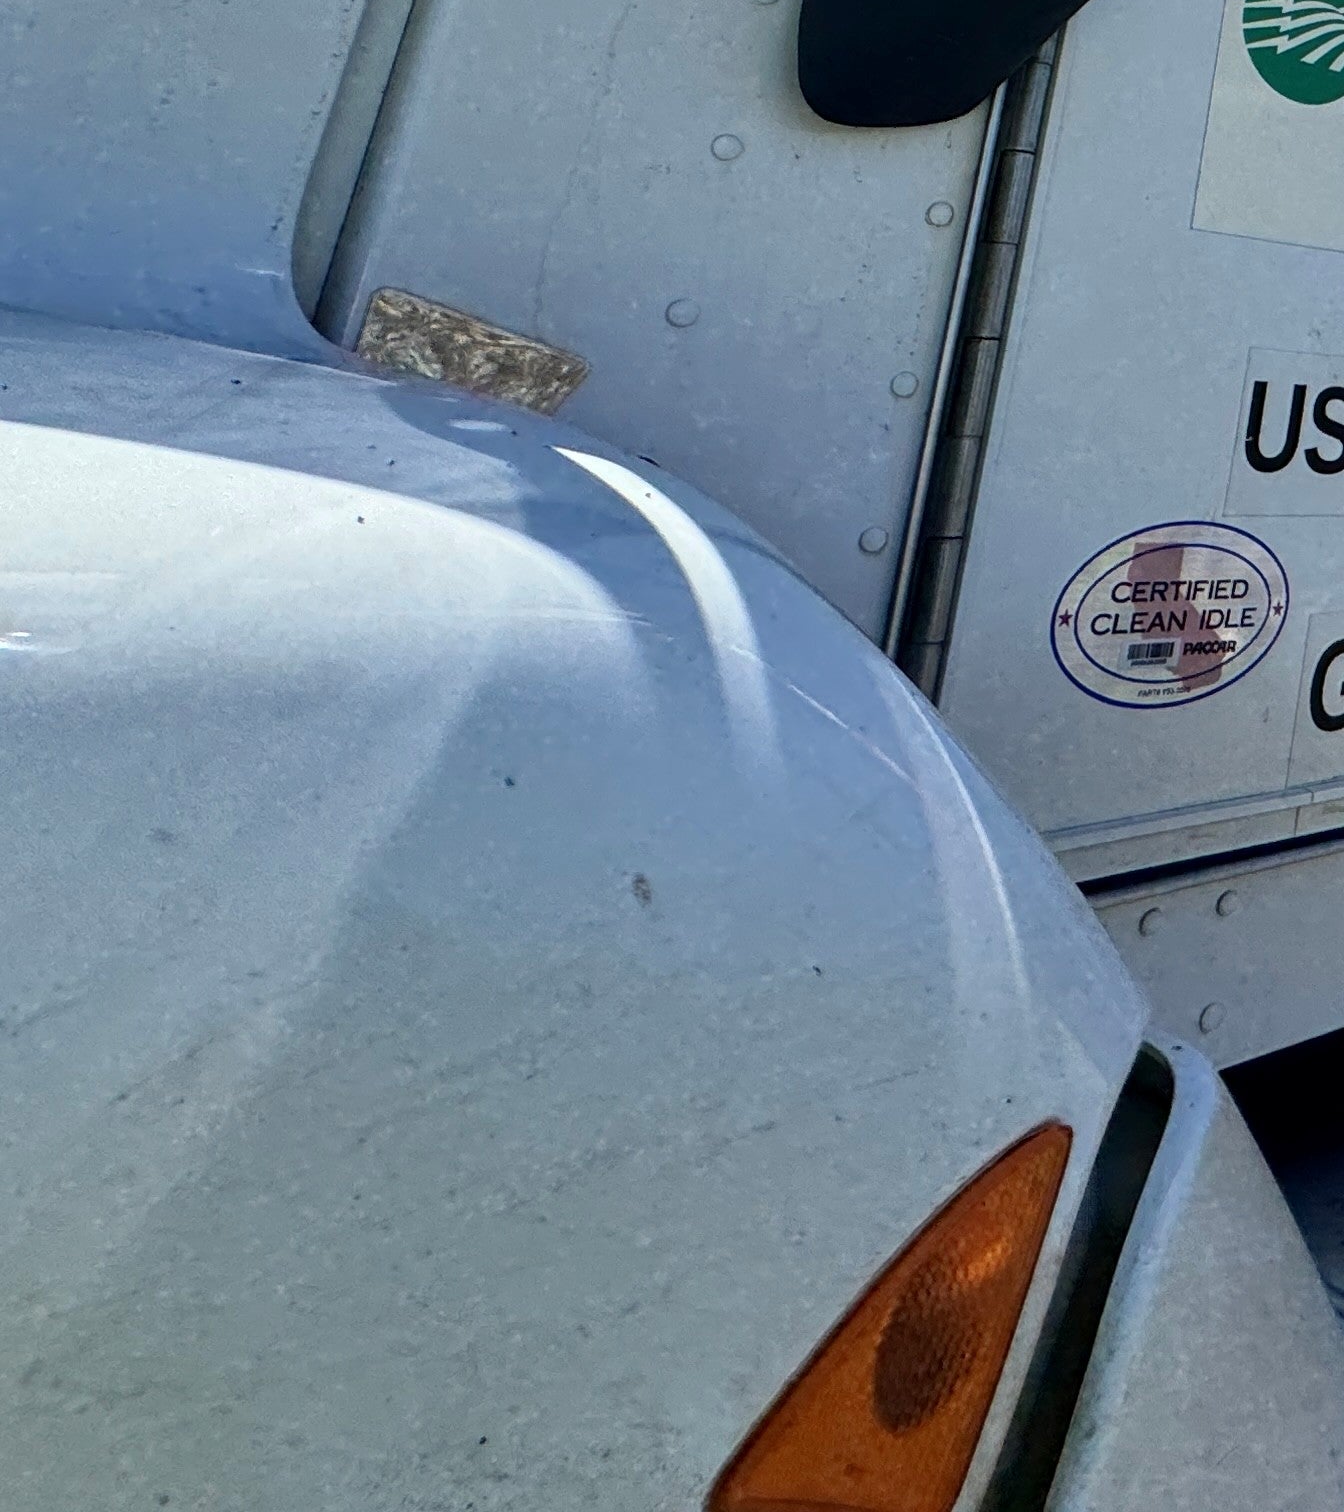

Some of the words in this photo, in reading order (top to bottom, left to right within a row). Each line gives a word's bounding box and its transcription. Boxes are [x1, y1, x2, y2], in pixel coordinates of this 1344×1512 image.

[1111, 578, 1249, 604] CERTIFIED
[1090, 610, 1188, 636] CLEAN
[1199, 607, 1257, 631] IDLE
[1182, 640, 1237, 656] PACCAR
